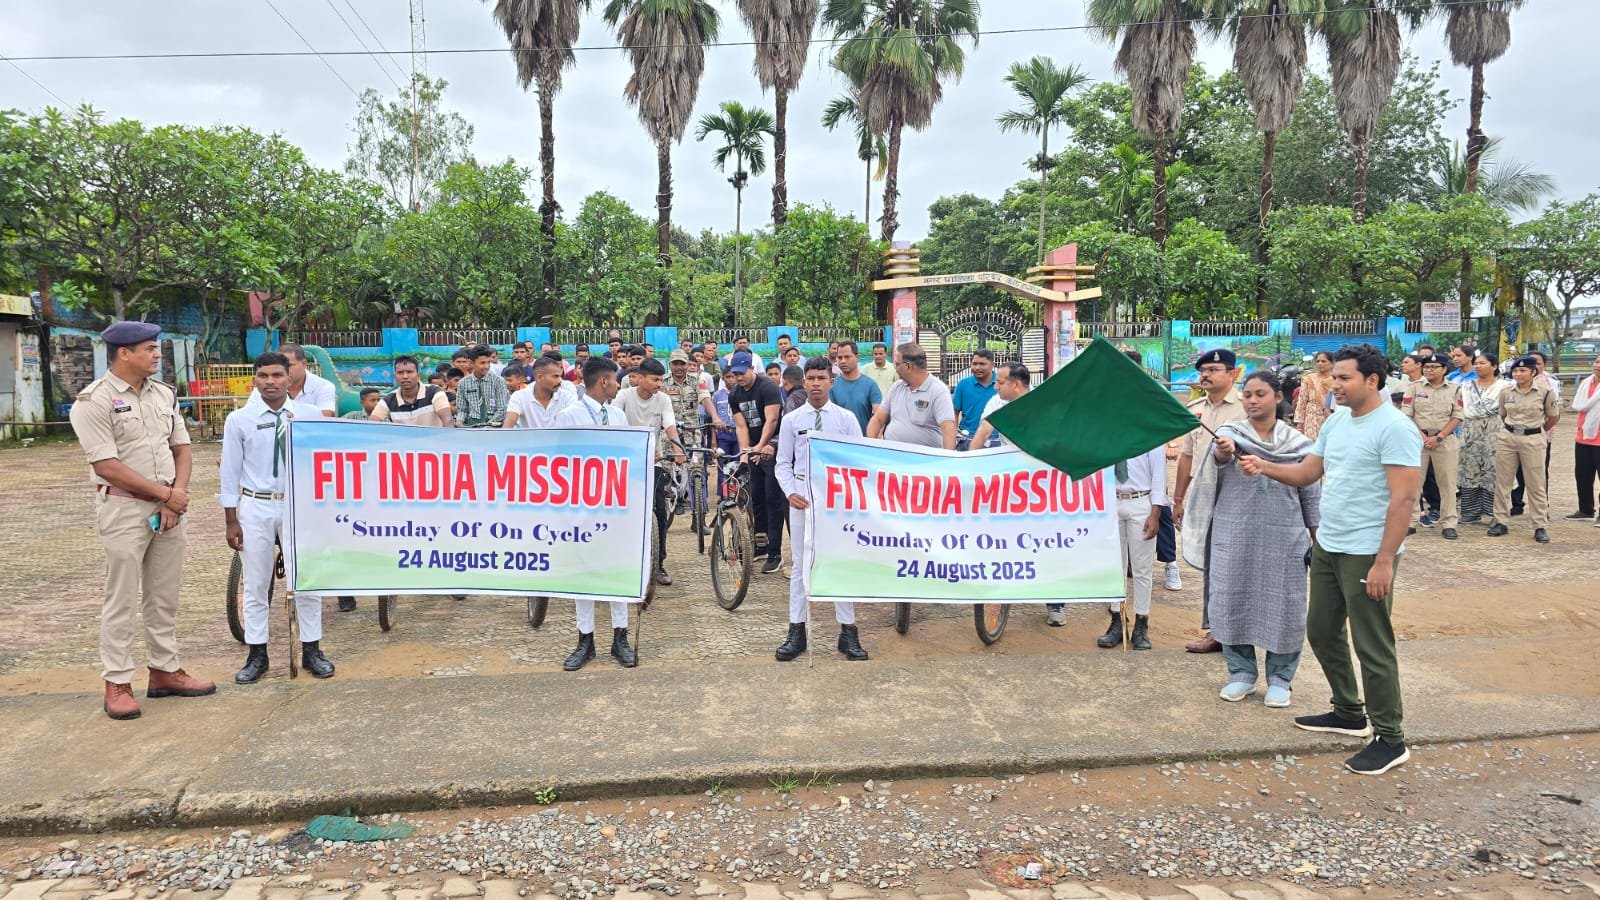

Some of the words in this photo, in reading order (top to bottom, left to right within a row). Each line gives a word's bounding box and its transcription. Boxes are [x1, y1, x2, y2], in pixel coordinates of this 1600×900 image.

[313, 451, 367, 500] FIT
[378, 452, 477, 501] INDIA
[487, 455, 628, 507] MISSION
[826, 466, 869, 510] FIT
[877, 471, 962, 514] INDIA
[971, 470, 1105, 514] MISSION
[450, 521, 482, 539] Of
[489, 522, 523, 540] On
[941, 533, 969, 550] Of
[976, 534, 1007, 550] On
[398, 549, 423, 569] 24
[429, 549, 497, 572] August
[503, 551, 550, 572] 2025
[897, 559, 920, 577] 24
[924, 560, 987, 583] August
[992, 561, 1036, 580] 2025
